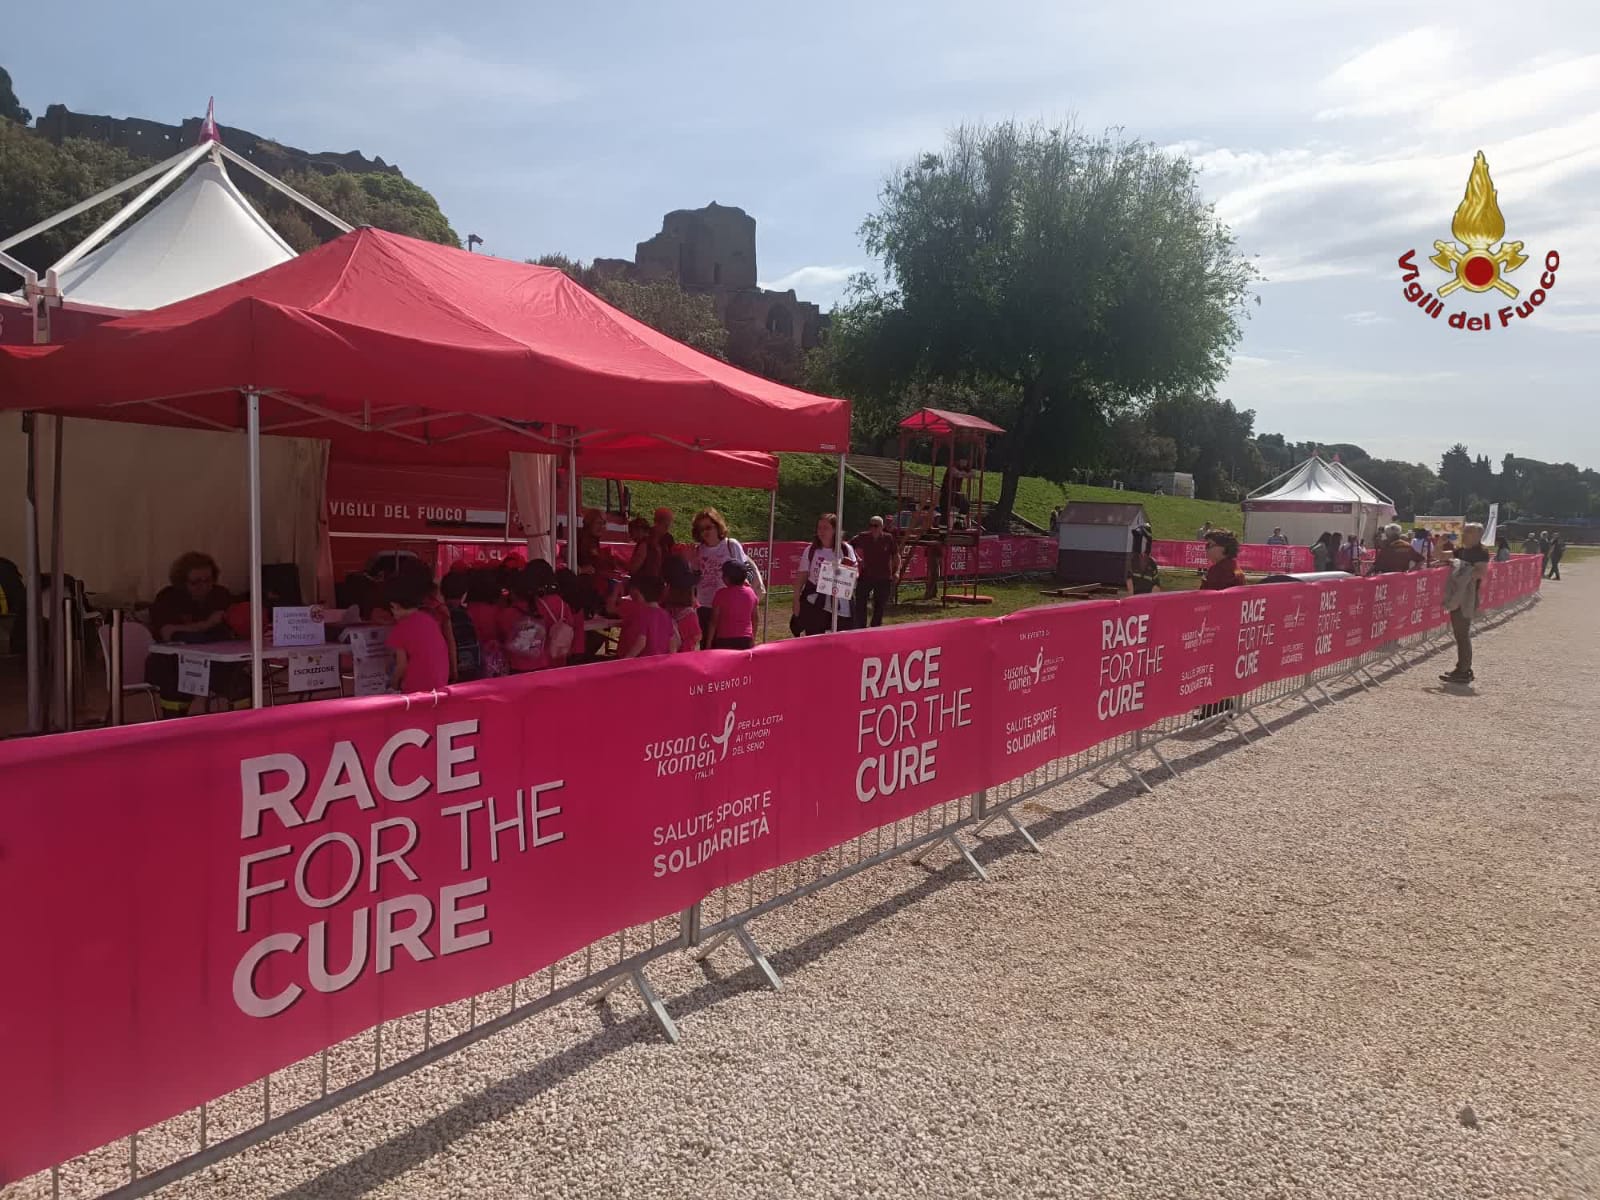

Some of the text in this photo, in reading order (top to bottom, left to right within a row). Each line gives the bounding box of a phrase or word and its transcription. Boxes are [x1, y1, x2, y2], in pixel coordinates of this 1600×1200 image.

[329, 502, 463, 522] VIGILI DEL FUOCO
[1240, 598, 1267, 625] RACE
[1320, 590, 1337, 612] RACE
[1102, 614, 1150, 651] RACE
[1237, 626, 1256, 652] FOR
[1256, 623, 1275, 646] THE
[1315, 633, 1333, 656] CURE
[860, 646, 942, 702] RACE
[1099, 650, 1134, 687] FOR
[1137, 644, 1165, 677] THE
[1235, 649, 1260, 679] CURE
[689, 675, 752, 696] UN EVENTO DI
[1097, 680, 1145, 721] CURE
[737, 714, 784, 731] PER LA LOTTA
[857, 687, 973, 753] FOR THE
[1032, 708, 1052, 726] SPORT
[1052, 706, 1057, 718] E
[732, 741, 765, 756] DEL SENO
[744, 728, 771, 741] TUMORI
[1006, 719, 1056, 755] SOLIDARIETÀ
[240, 719, 481, 840] RACE
[855, 739, 938, 803] CURE
[716, 793, 761, 823] SPORT
[762, 790, 772, 808] E
[237, 780, 564, 932] FOR THE
[653, 811, 770, 878] SOLIDARIETÀ
[232, 877, 491, 1018] CURE
